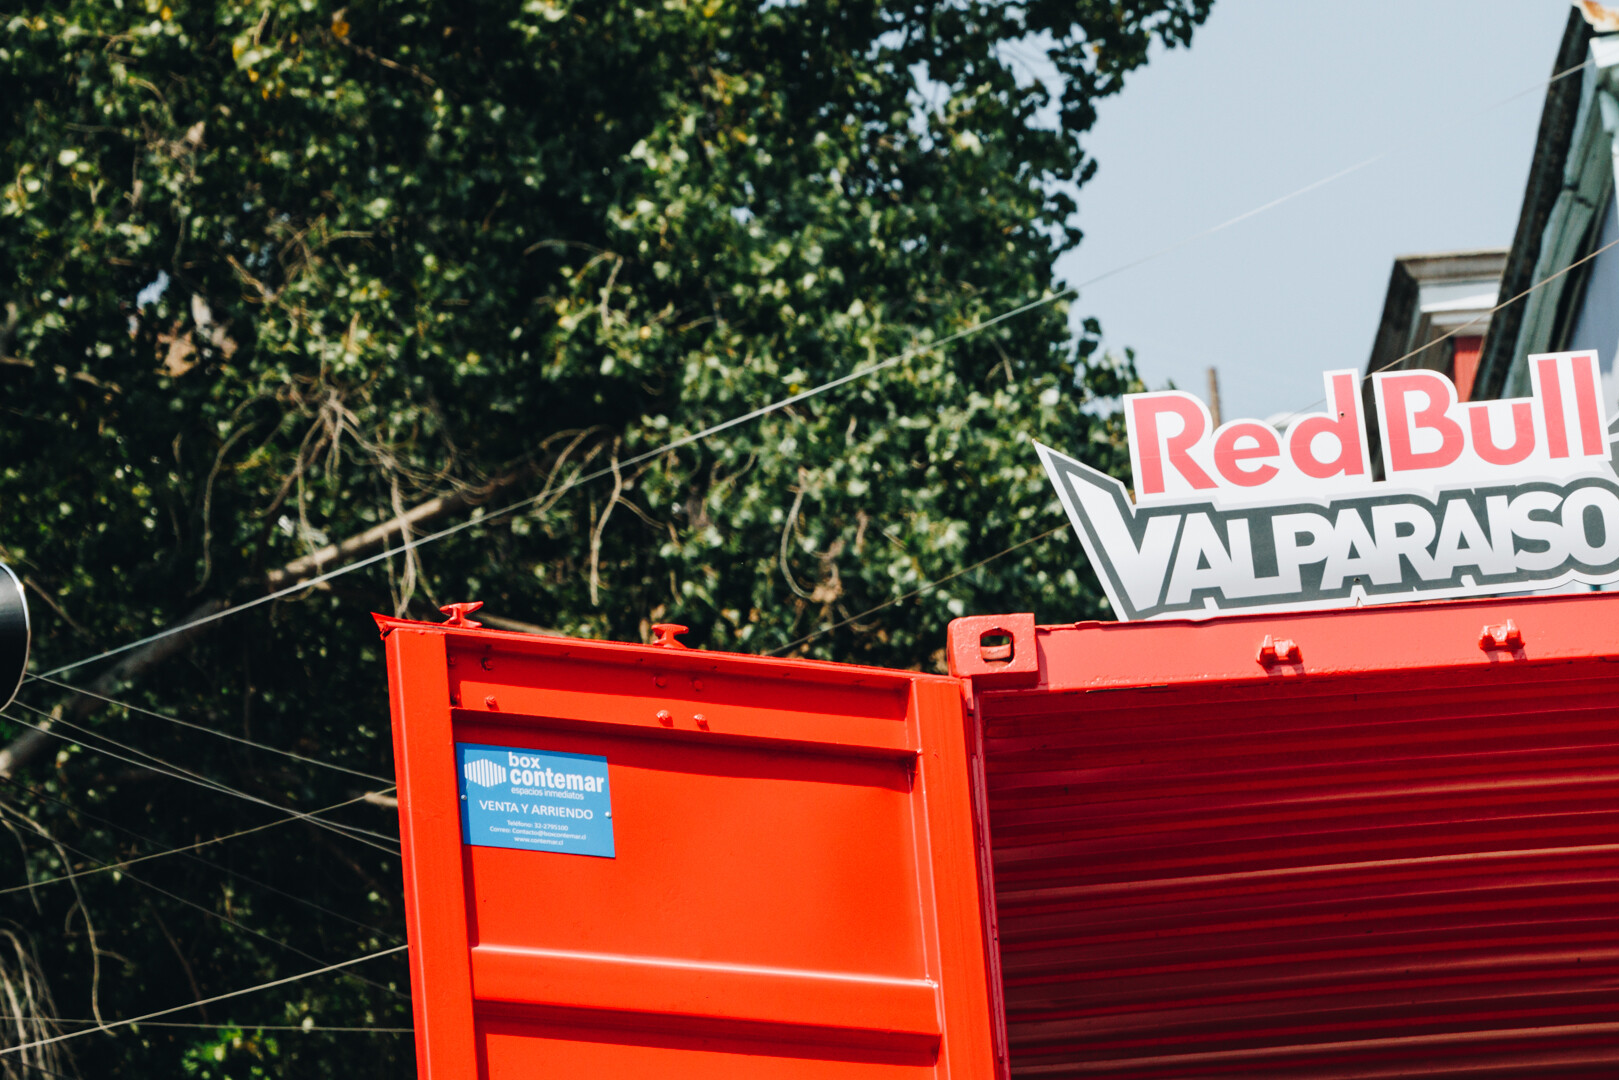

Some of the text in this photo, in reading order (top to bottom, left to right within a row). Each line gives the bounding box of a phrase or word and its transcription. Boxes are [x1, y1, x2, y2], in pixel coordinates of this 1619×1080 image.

[1131, 353, 1603, 496] Red Bull
[508, 751, 541, 769] box
[510, 768, 604, 792] contemar
[511, 786, 584, 800] espacios inmediatos
[479, 800, 593, 820] VENTA Y ARRIENDO
